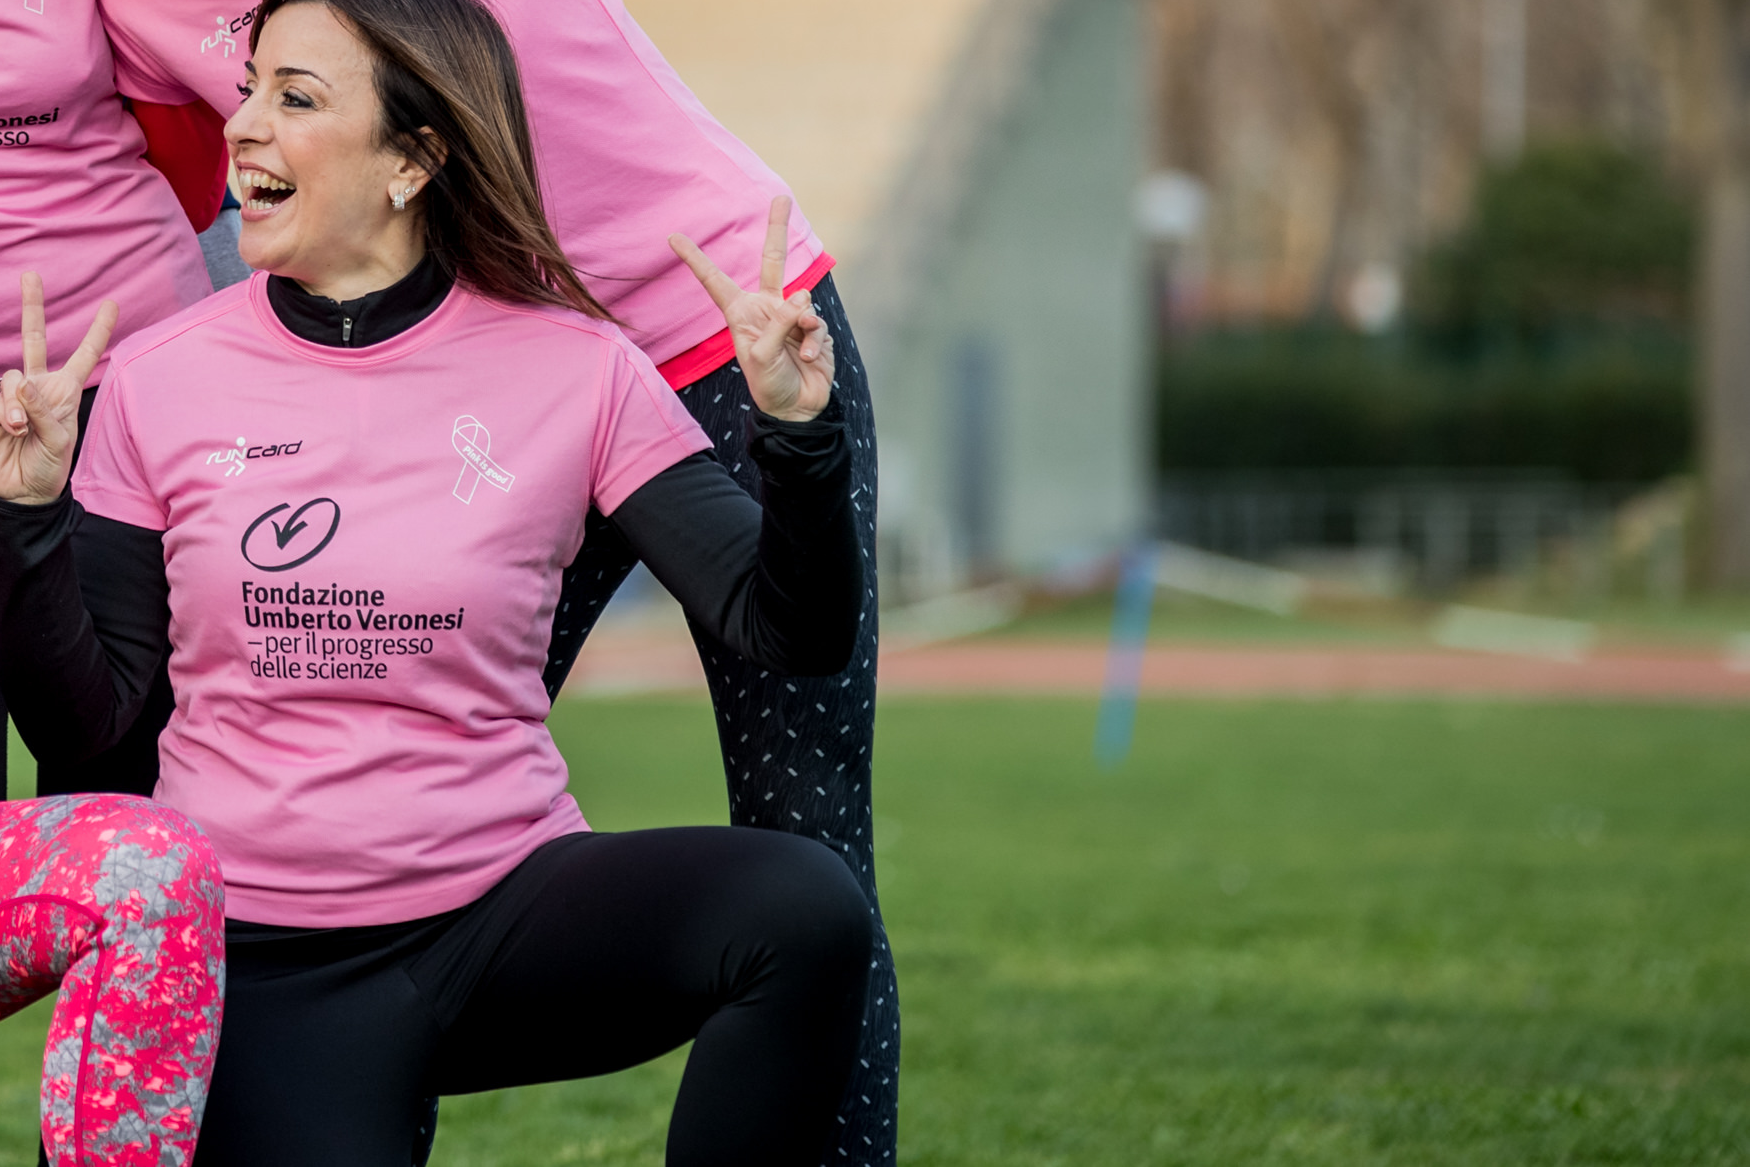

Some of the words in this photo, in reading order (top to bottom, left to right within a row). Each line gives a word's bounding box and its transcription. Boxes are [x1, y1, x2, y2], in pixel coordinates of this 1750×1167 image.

[462, 445, 481, 464] Pink
[479, 459, 488, 470] is
[485, 468, 509, 484] good
[242, 581, 385, 606] Fondazione
[244, 606, 351, 630] Umberto
[356, 607, 464, 630] Veronesi
[306, 632, 317, 654] il
[322, 637, 433, 660] progresso
[250, 654, 301, 679] delle
[306, 657, 387, 679] scienze
